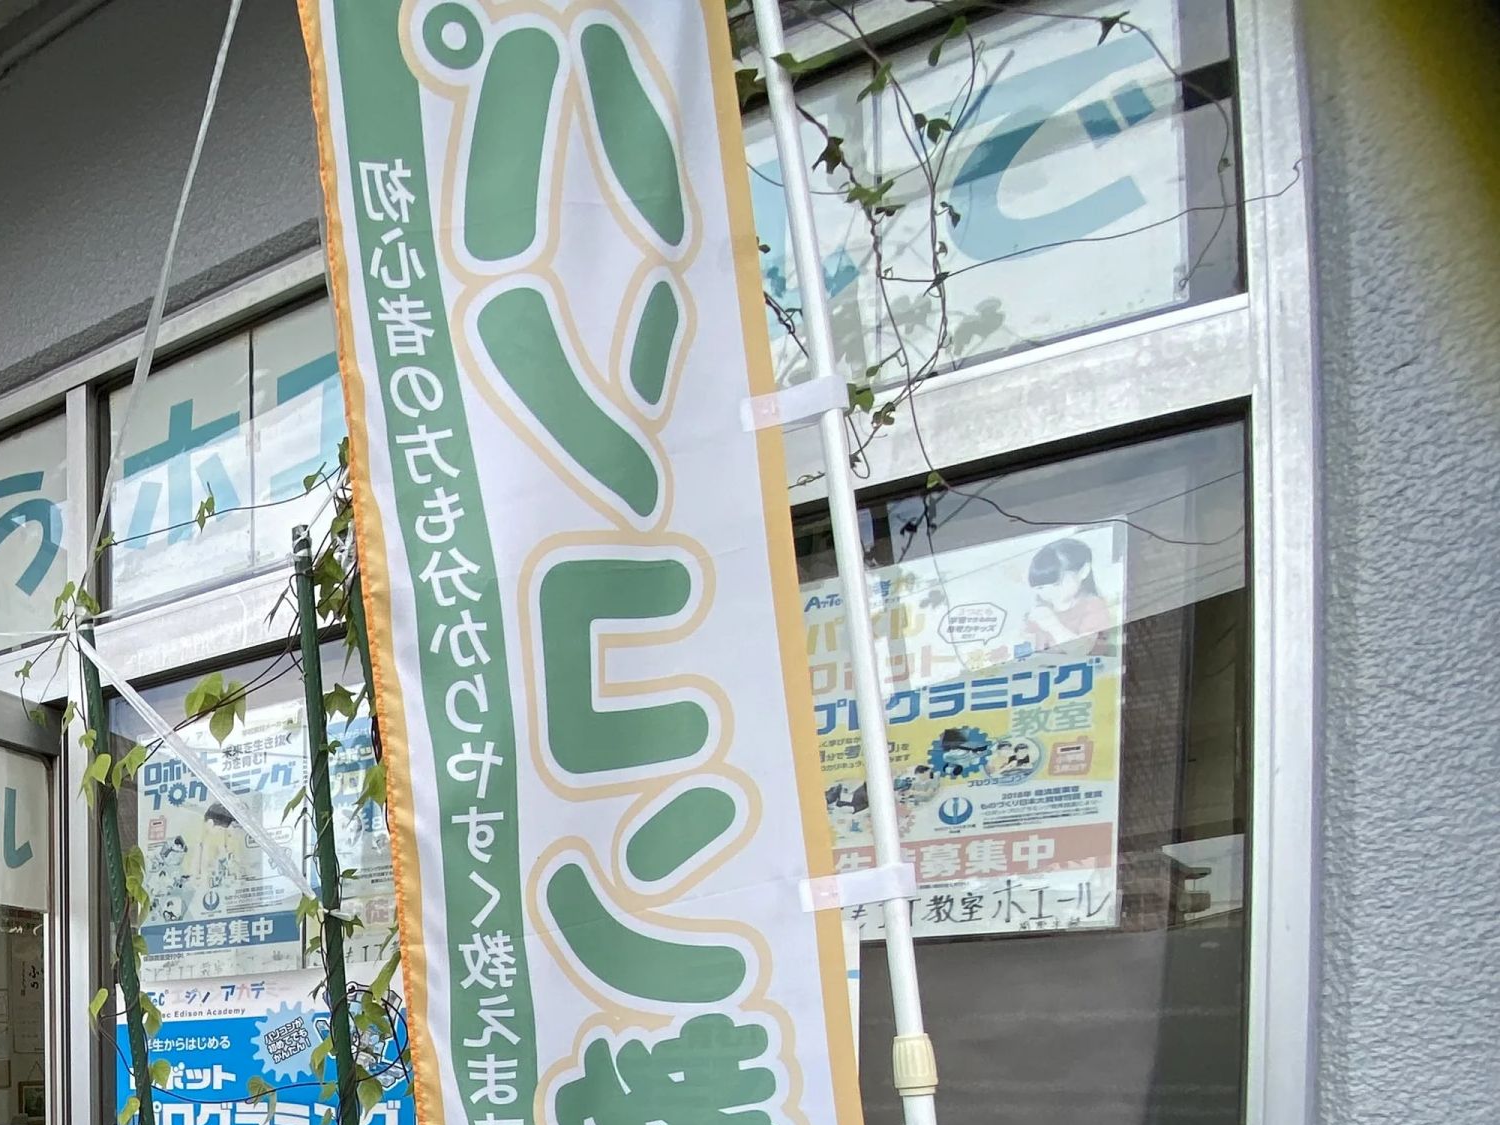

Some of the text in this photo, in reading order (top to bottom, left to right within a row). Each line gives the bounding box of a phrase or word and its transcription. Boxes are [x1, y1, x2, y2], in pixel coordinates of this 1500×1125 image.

[1011, 701, 1092, 735] 教室
[837, 835, 1055, 876] 生募集中
[162, 916, 274, 951] 生徒募集中
[174, 1007, 245, 1018] Edison Academy
